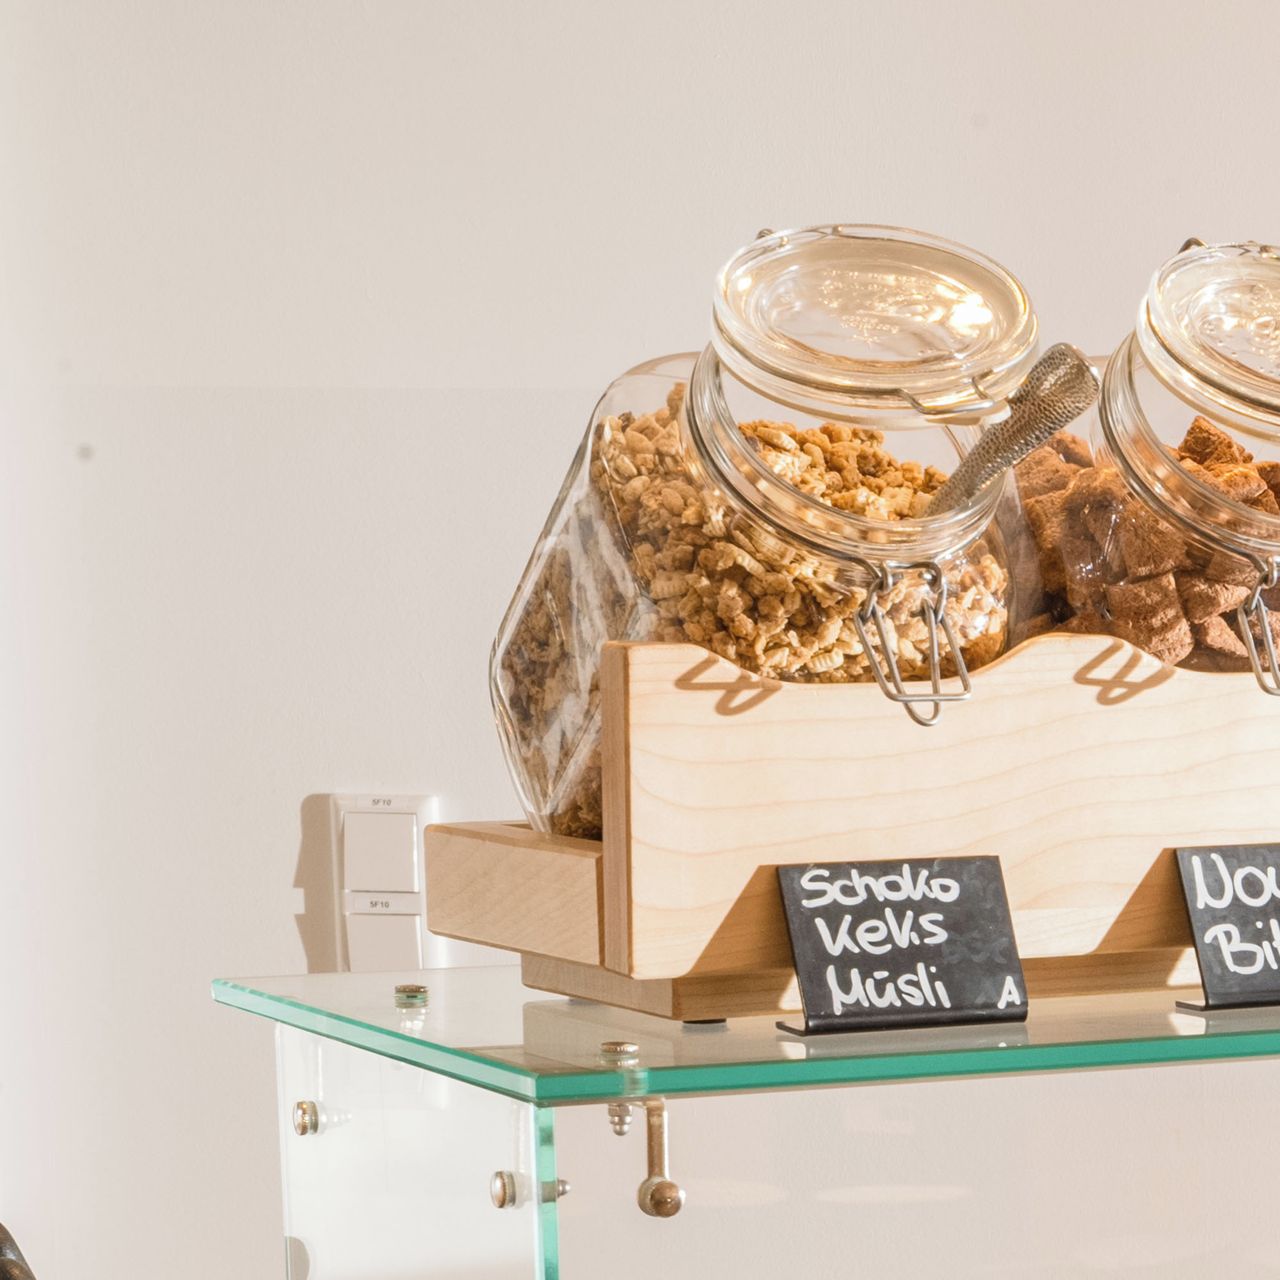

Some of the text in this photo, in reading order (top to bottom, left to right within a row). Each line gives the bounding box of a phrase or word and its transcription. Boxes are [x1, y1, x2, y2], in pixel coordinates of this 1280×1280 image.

[801, 864, 960, 908] Schoko
[815, 907, 948, 956] Keks
[826, 962, 951, 1015] Müsli
[997, 976, 1021, 1009] A
